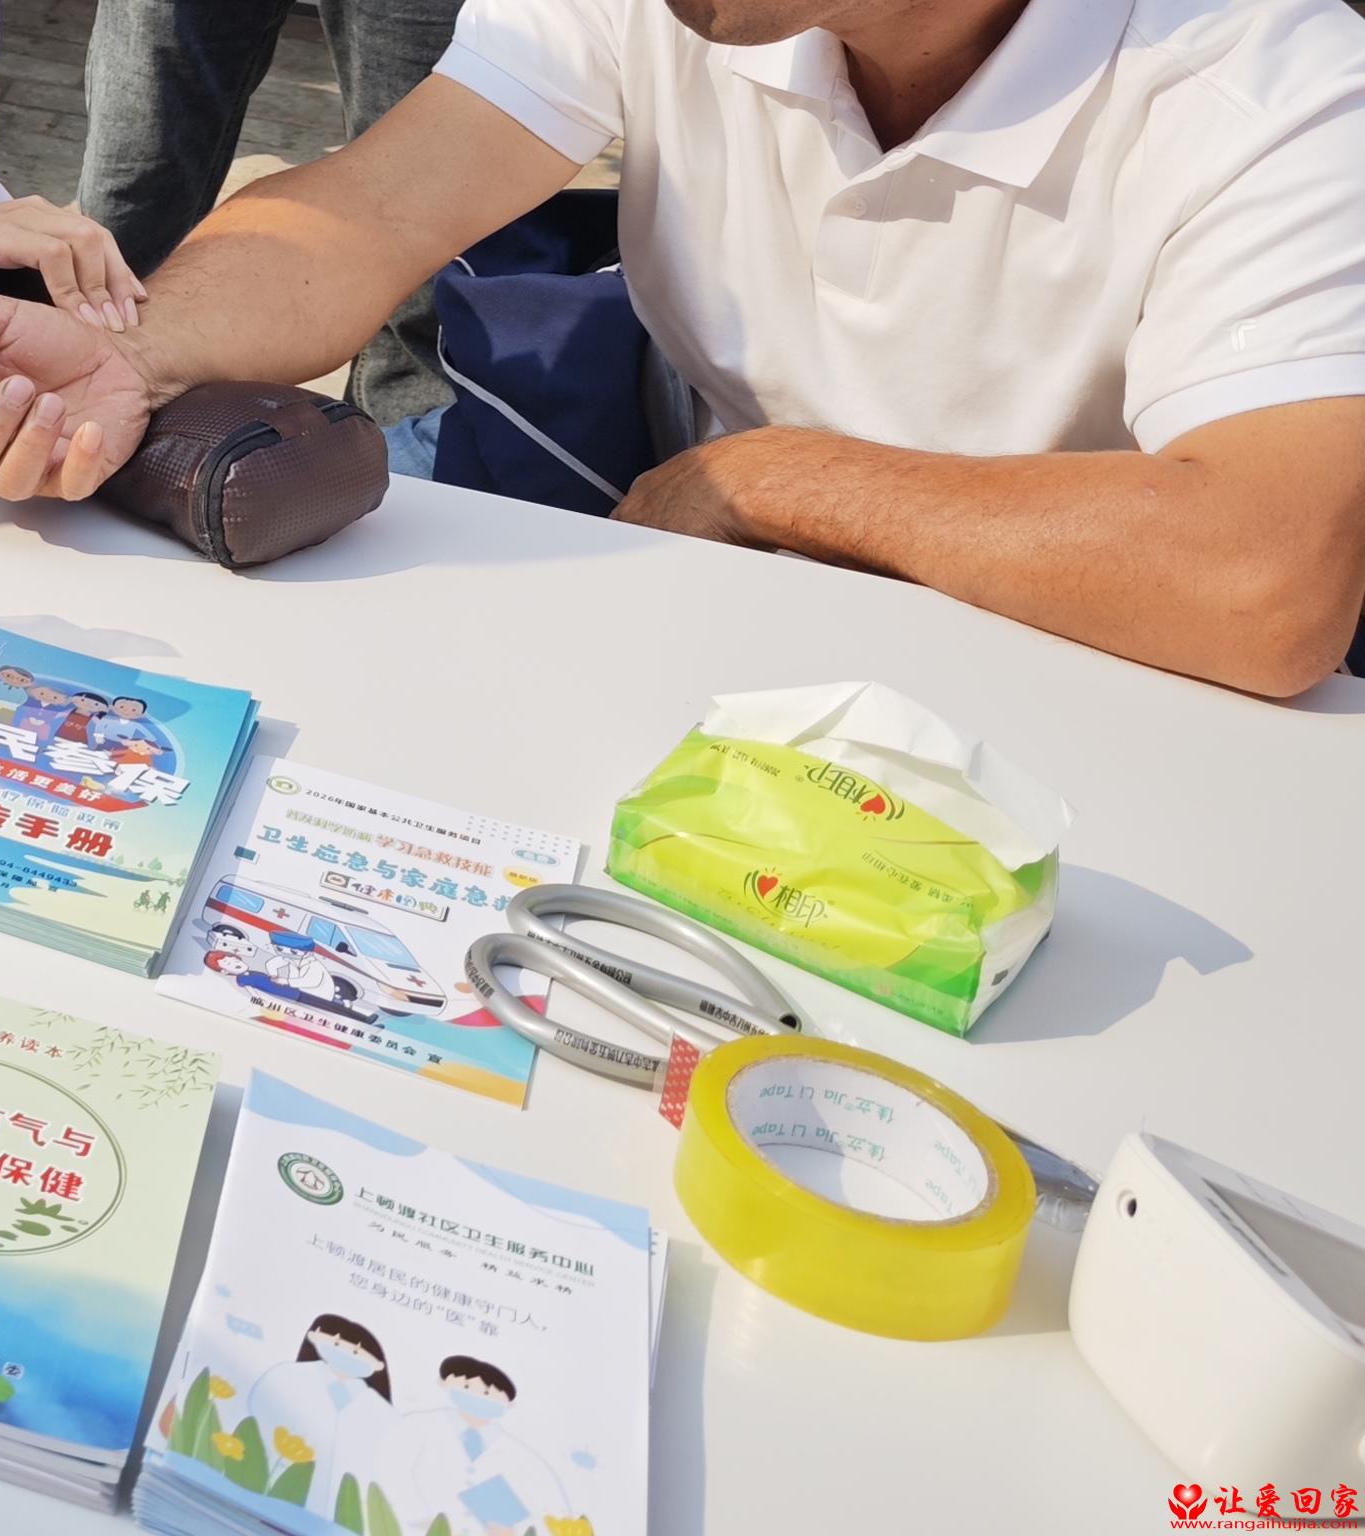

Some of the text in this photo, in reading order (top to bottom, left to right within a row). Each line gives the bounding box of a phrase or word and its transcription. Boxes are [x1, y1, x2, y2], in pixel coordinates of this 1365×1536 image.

[759, 1083, 794, 1100] Tape
[800, 1086, 815, 1099] Li
[824, 1089, 848, 1105] Jia
[751, 1119, 785, 1137] Tape
[792, 1123, 806, 1138] Li
[815, 1127, 838, 1145] Jia
[352, 1185, 596, 1278] 上顿渡社区卫生服务中心
